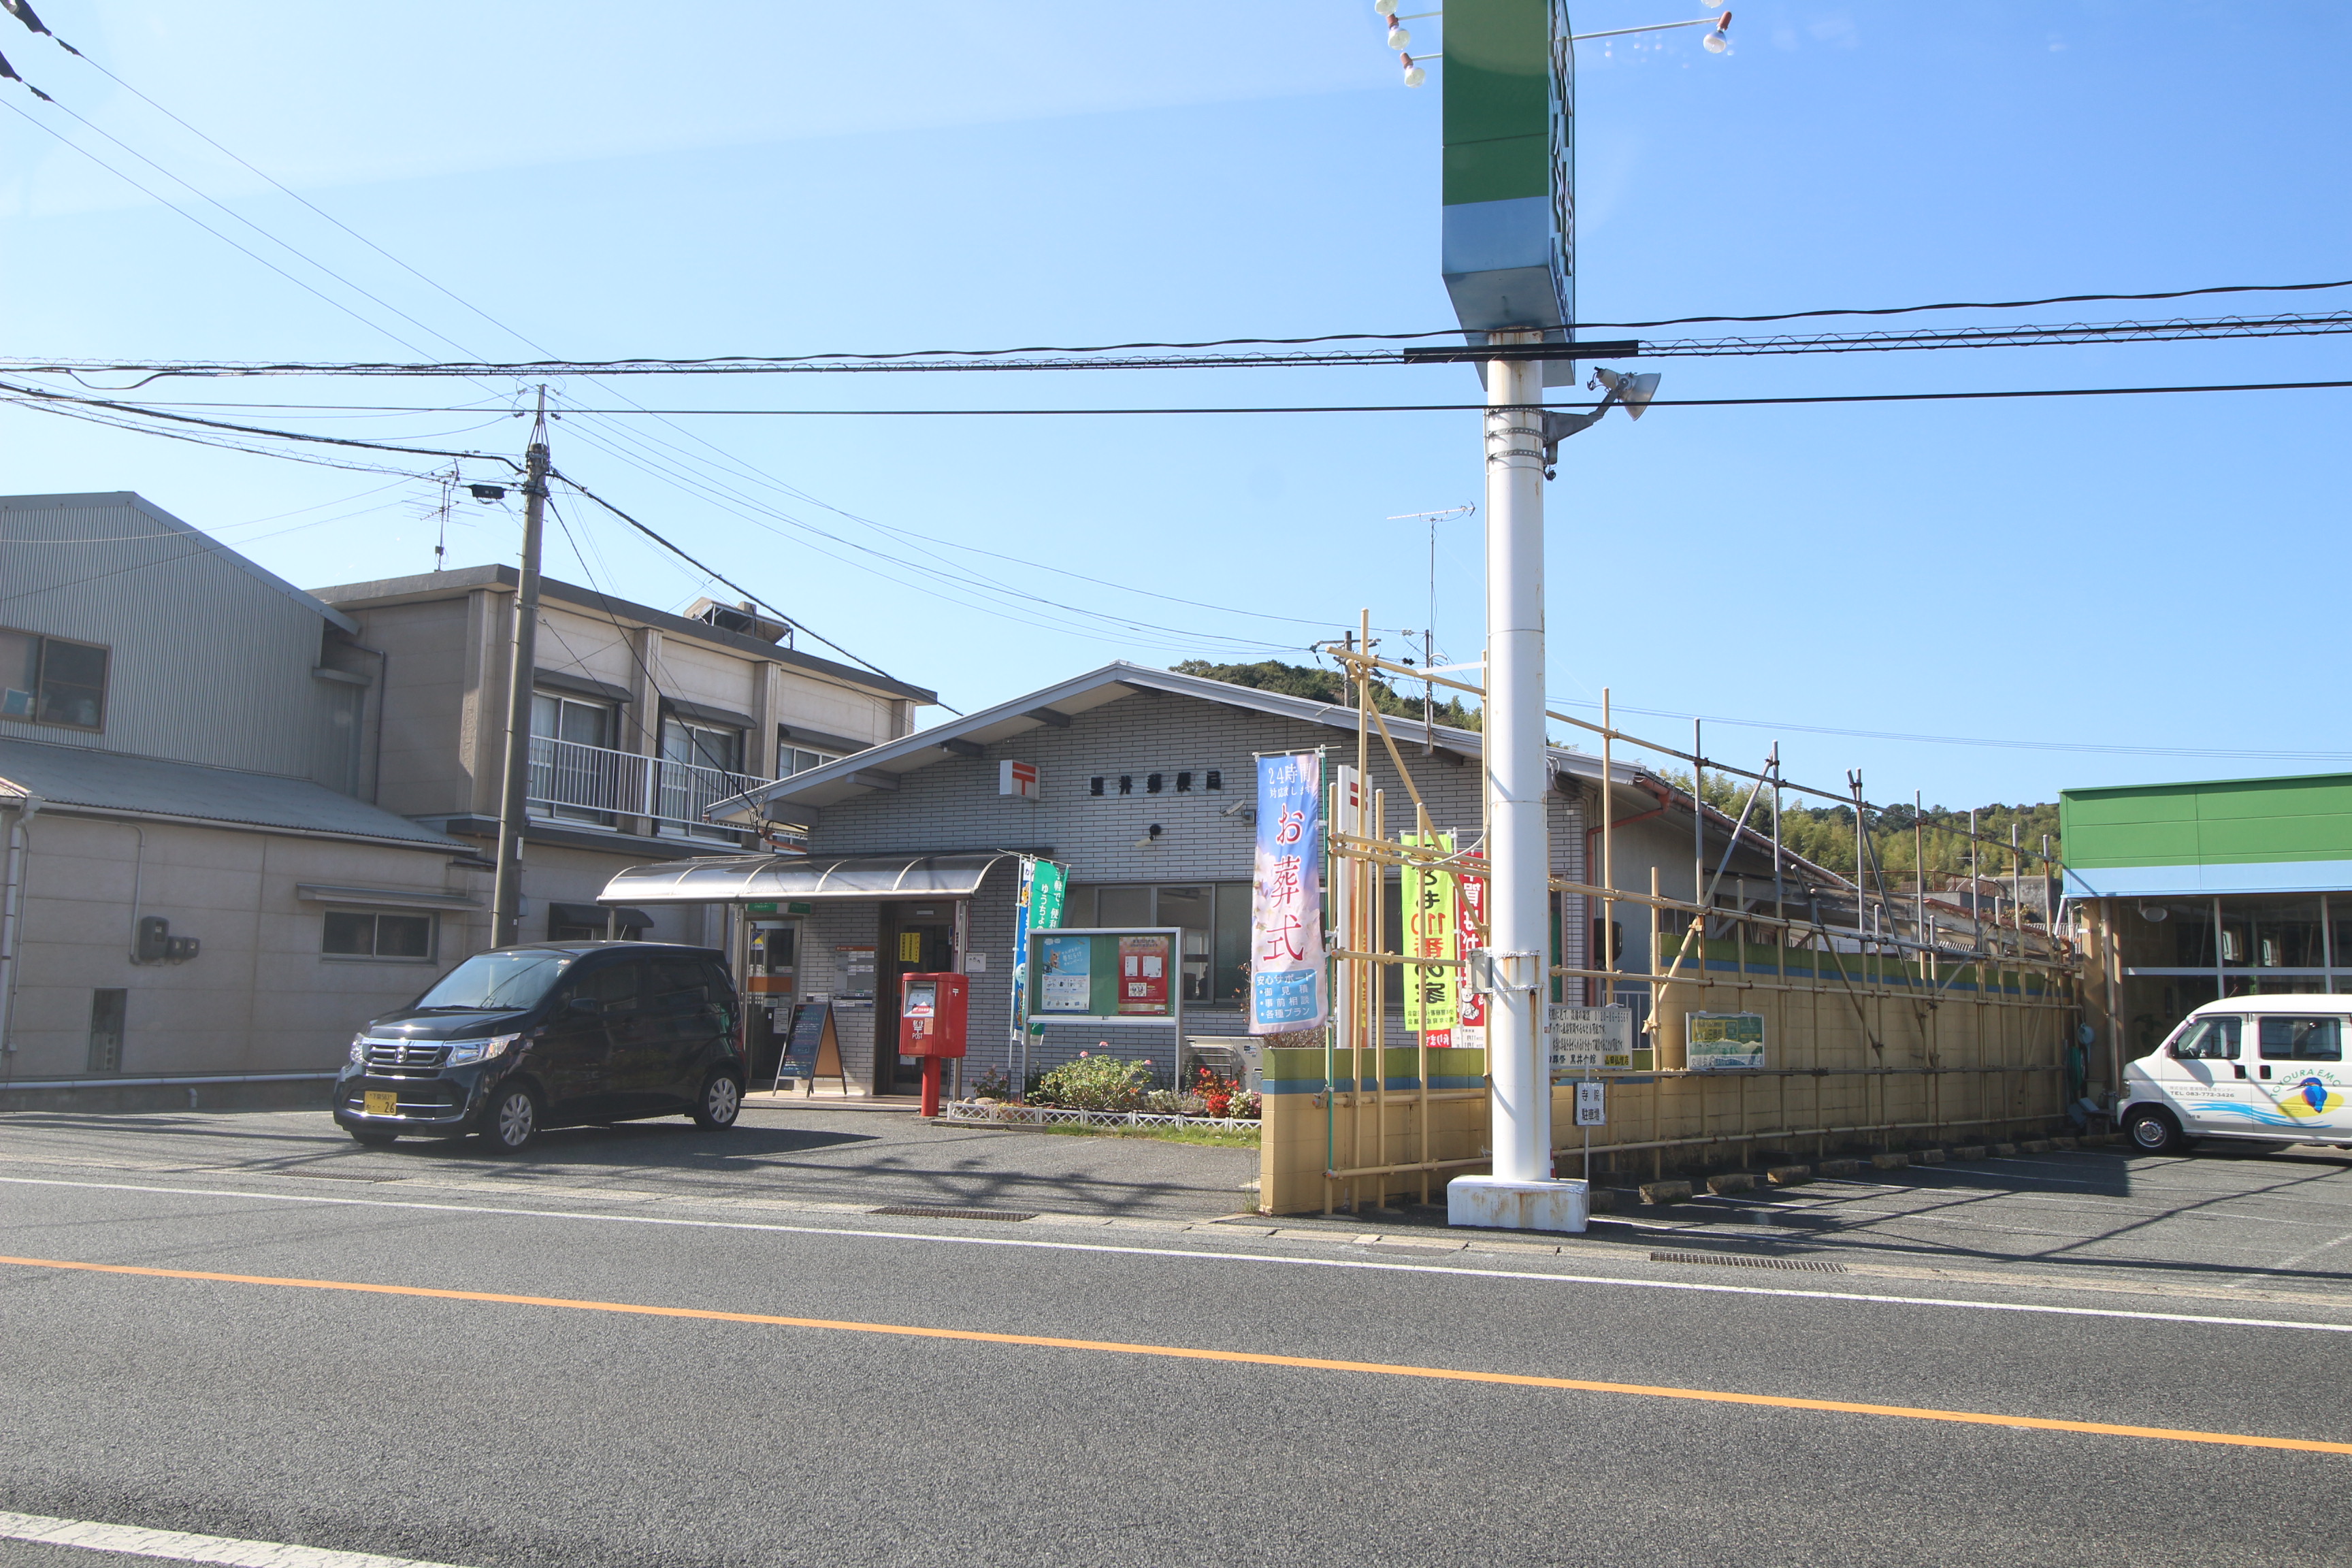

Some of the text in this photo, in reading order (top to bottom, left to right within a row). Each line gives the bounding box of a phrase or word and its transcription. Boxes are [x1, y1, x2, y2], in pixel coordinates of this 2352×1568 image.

[1268, 764, 1311, 785] 24時間
[1262, 803, 1305, 961] お葬式
[1257, 973, 1313, 986] 安心サポート
[2270, 1068, 2314, 1098] TOYOURA
[1582, 1108, 1599, 1120] 駐車場
